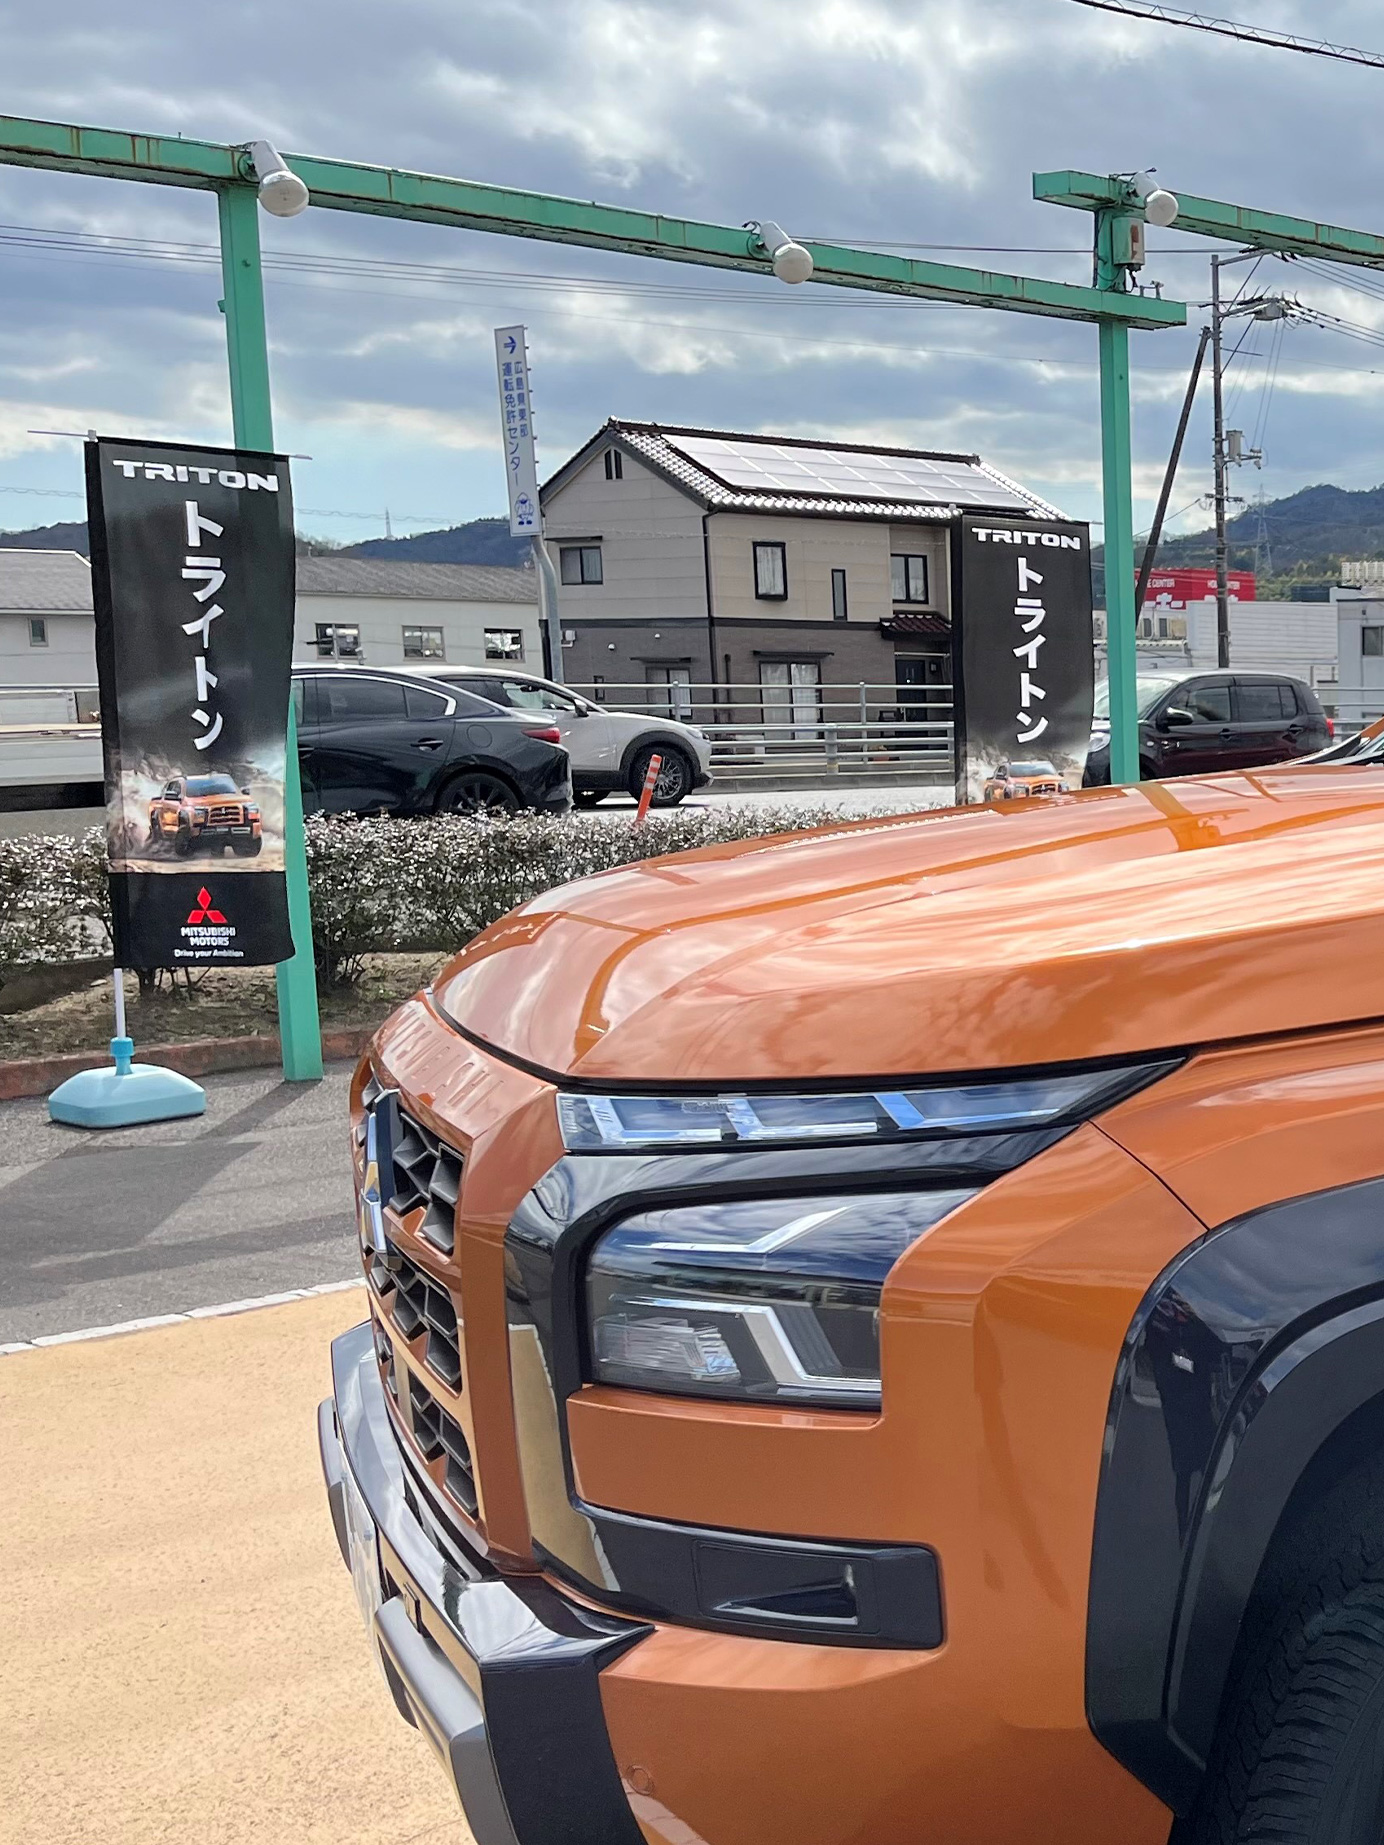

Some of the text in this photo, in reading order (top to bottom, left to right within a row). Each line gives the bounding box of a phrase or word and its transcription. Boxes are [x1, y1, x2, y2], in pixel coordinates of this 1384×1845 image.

[502, 362, 521, 486] 運転免許センター
[112, 459, 279, 492] TRITON
[971, 527, 1081, 550] TRITON
[181, 500, 227, 751] トライトン
[1012, 557, 1049, 744] トライトン
[180, 926, 237, 937] MITSUBISHI
[189, 936, 230, 946] MOTORS
[174, 948, 244, 959] Drive your Ambition
